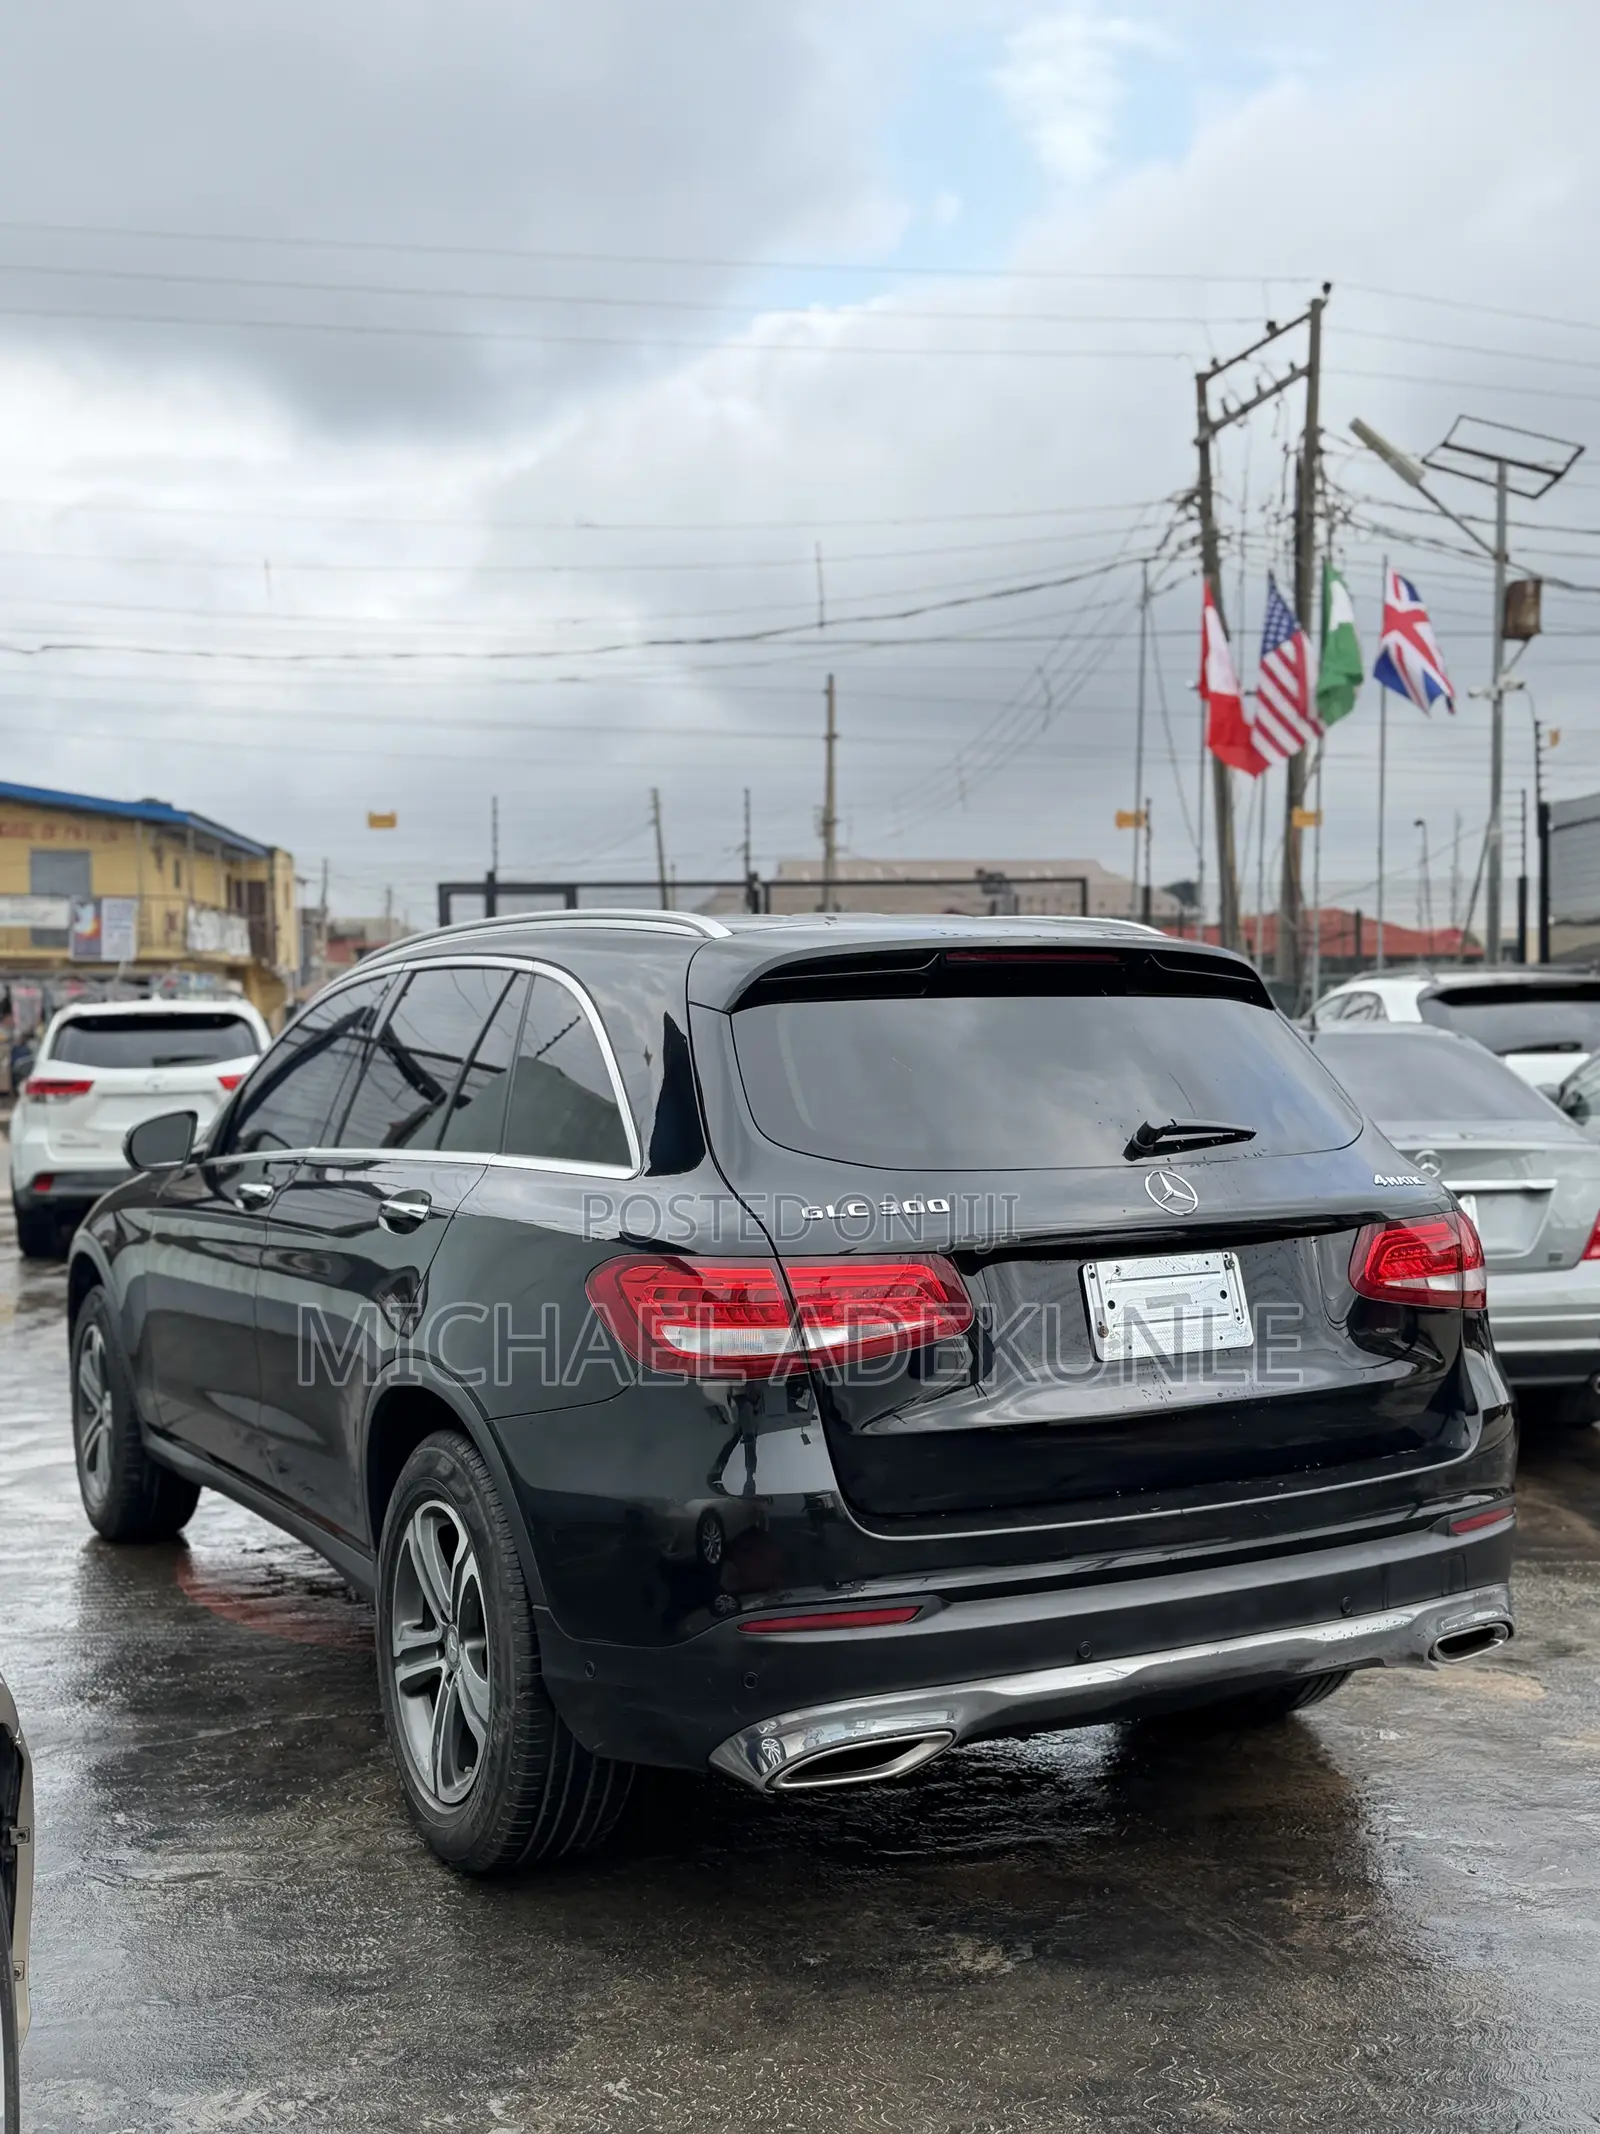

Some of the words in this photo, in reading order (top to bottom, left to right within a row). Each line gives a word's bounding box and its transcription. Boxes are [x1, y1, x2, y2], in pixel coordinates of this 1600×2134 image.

[1373, 1174, 1427, 1187] 4MATIC
[801, 1203, 869, 1221] GLC
[878, 1198, 950, 1216] 300
